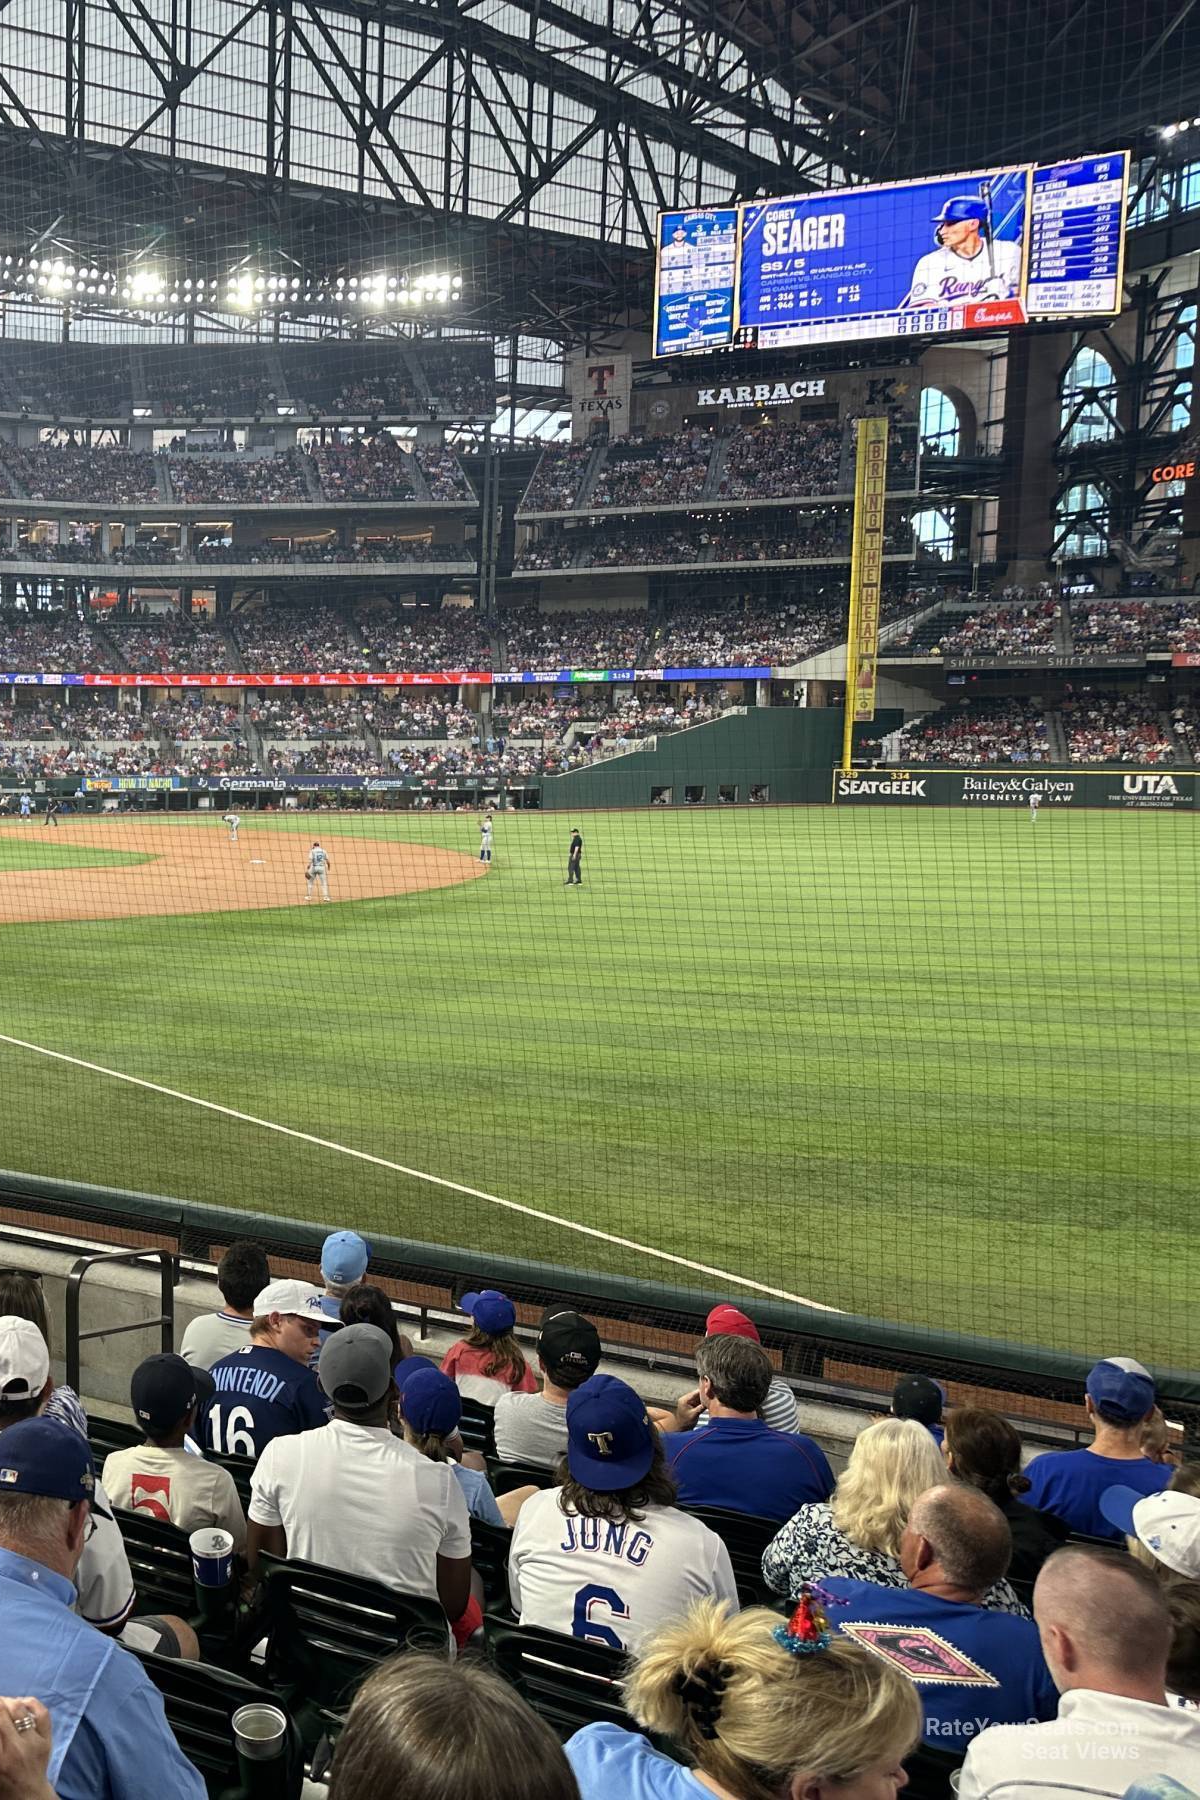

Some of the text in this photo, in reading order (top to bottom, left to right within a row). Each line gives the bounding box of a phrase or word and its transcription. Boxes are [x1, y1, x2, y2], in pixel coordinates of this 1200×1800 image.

[766, 208, 796, 223] COREY
[762, 213, 845, 256] SEAGER
[761, 262, 783, 273] SS
[794, 258, 805, 269] 5
[813, 269, 850, 280] KANSAS
[853, 268, 875, 278] CITY
[588, 365, 615, 396] T
[697, 379, 826, 406] KARBACH
[579, 399, 622, 413] TEXAS
[1152, 463, 1195, 482] CORE
[863, 445, 881, 652] BRING THE HEAT
[950, 659, 986, 668] SHIFT
[1048, 657, 1084, 666] SHIFT
[613, 672, 631, 680] 1:43
[119, 778, 136, 789] HOW
[138, 778, 147, 788] TO
[149, 778, 172, 788] NACHO
[220, 777, 286, 788] Germania
[840, 771, 858, 780] 329
[890, 772, 910, 780] 334
[839, 780, 926, 797] SEATGEEK
[962, 777, 1074, 794] Bailey&Galyen
[1123, 775, 1179, 794] UTA
[1050, 794, 1072, 802] LAW
[209, 1366, 286, 1403] NINTENDI
[209, 1403, 257, 1458] 16
[587, 1431, 614, 1455] T
[560, 1516, 654, 1567] JUNG
[571, 1583, 631, 1650] 6
